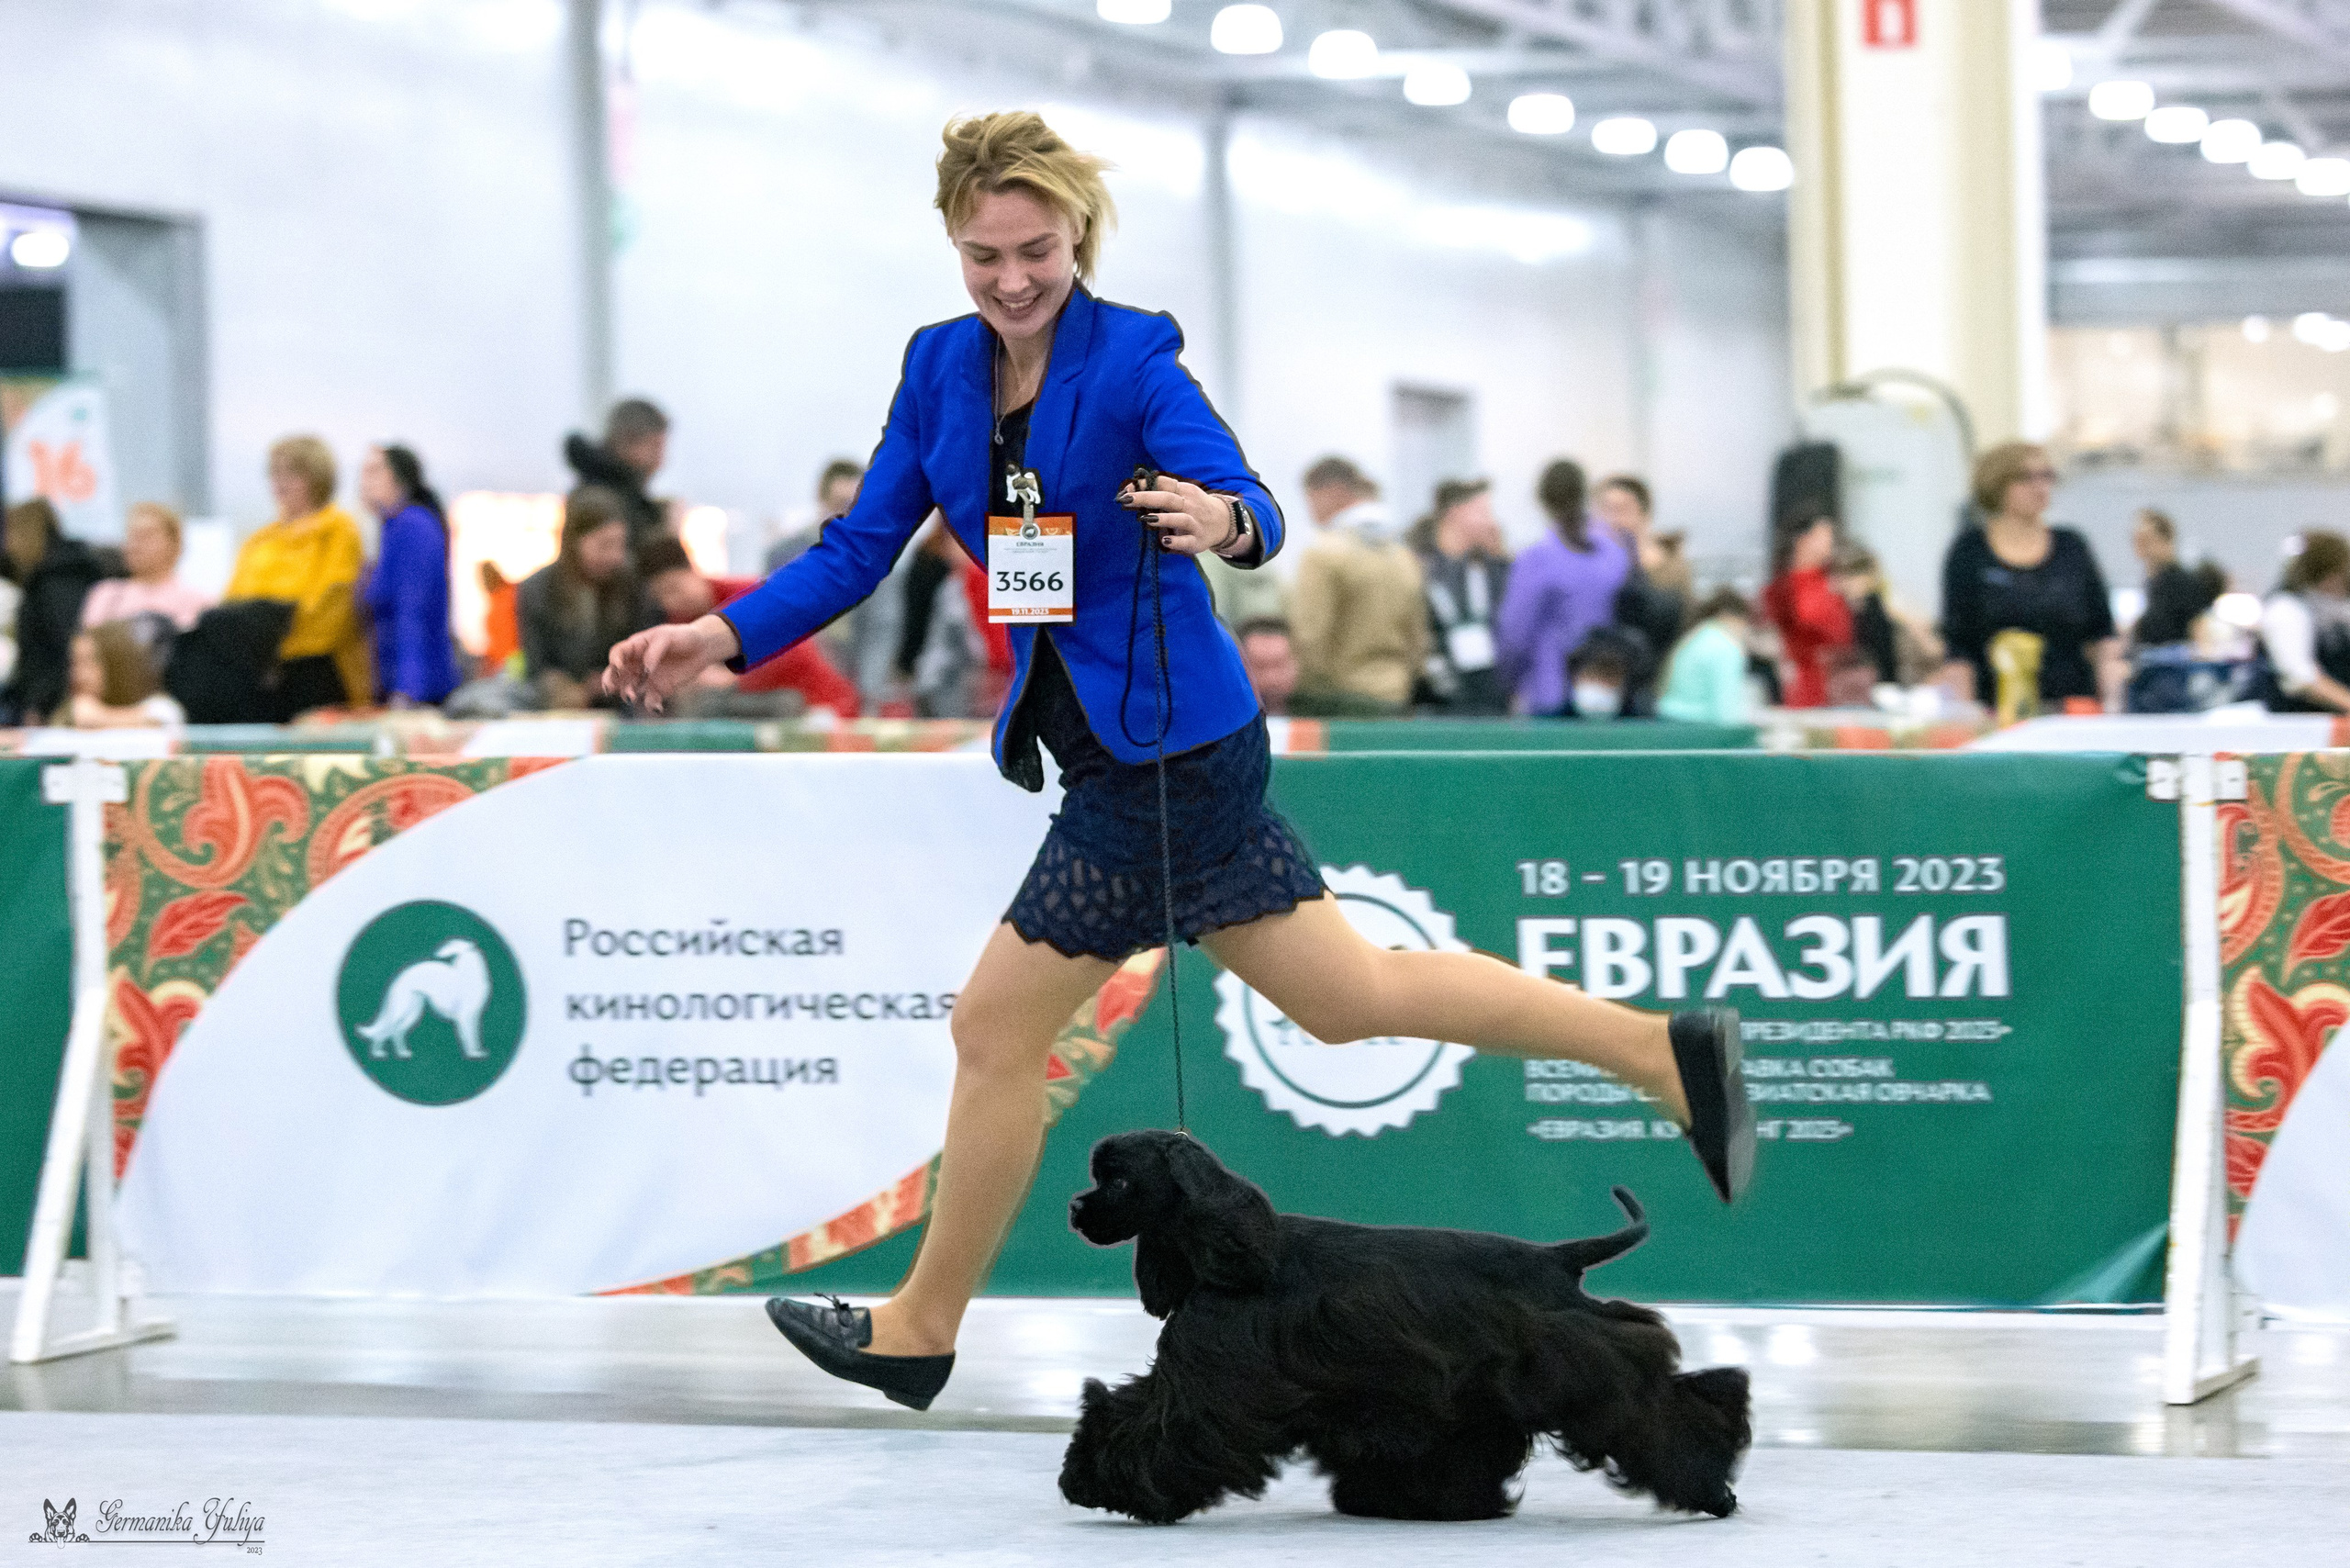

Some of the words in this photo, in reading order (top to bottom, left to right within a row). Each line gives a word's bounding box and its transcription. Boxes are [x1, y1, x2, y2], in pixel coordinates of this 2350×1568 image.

[996, 571, 1064, 592] 3566
[1012, 608, 1049, 616] 19.11.2023
[1517, 859, 1569, 896] 18
[1619, 858, 1672, 895] 19
[1684, 857, 1880, 894] НОЯБРЯ
[1892, 856, 2006, 893] 2023
[563, 917, 844, 958] Российская
[1516, 914, 2009, 1000] ЕВРАЗИЯ
[565, 991, 957, 1022] кинологическая
[566, 1043, 839, 1098] федерация
[1807, 1058, 1895, 1079] СОБАК
